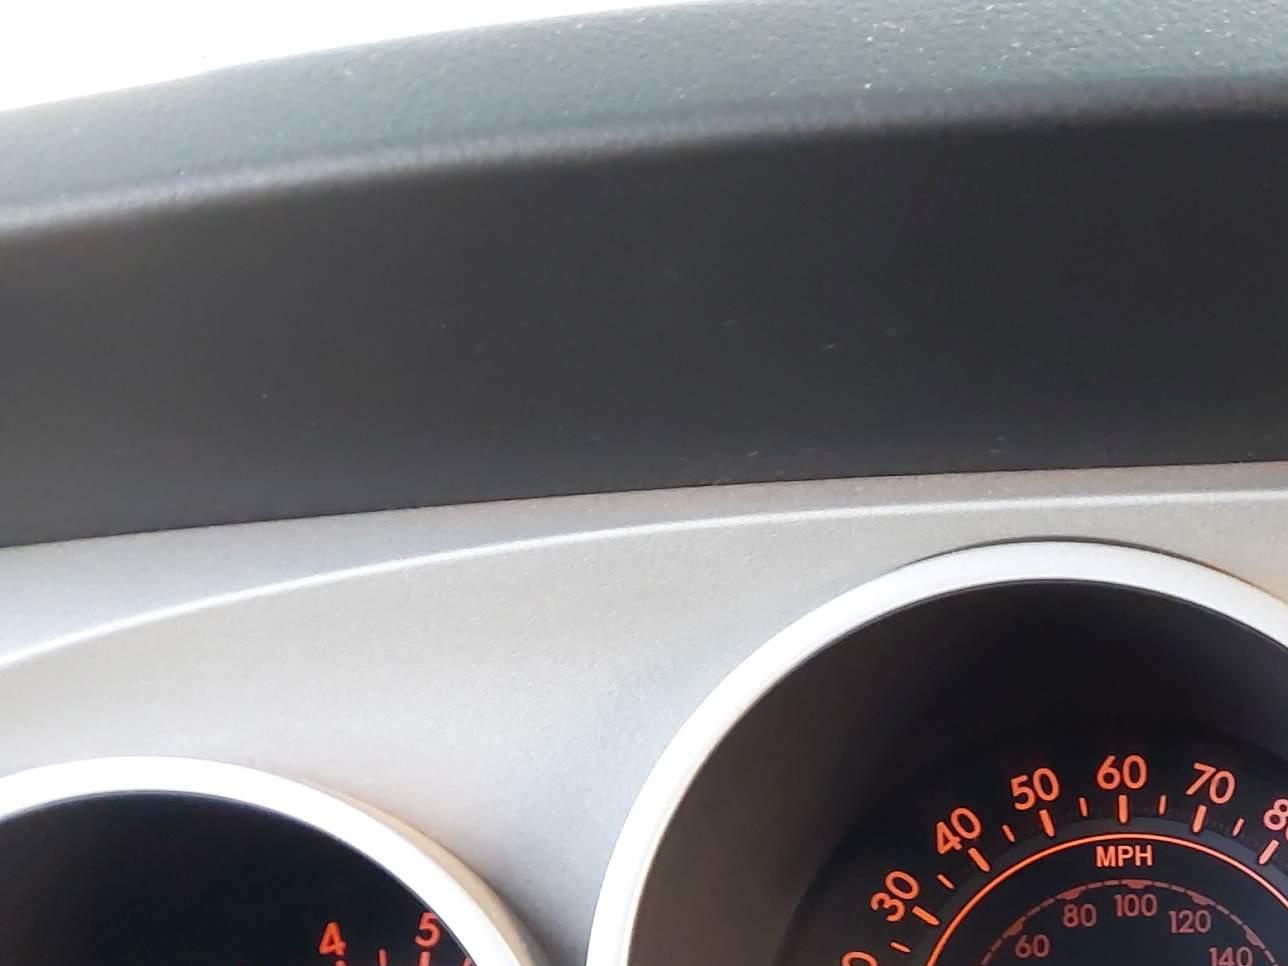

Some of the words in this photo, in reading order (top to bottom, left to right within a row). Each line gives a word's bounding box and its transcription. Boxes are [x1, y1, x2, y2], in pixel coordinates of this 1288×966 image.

[1010, 767, 1060, 811] 50
[1096, 754, 1147, 790] 60
[1185, 762, 1236, 804] 70
[936, 807, 982, 855] 40
[1096, 844, 1153, 868] MPH
[870, 870, 919, 921] 30
[1114, 893, 1158, 917] 100
[415, 912, 440, 948] 5
[1062, 903, 1097, 928] 80
[1168, 909, 1212, 934] 120
[319, 922, 346, 956] 4
[1015, 934, 1050, 959] 60
